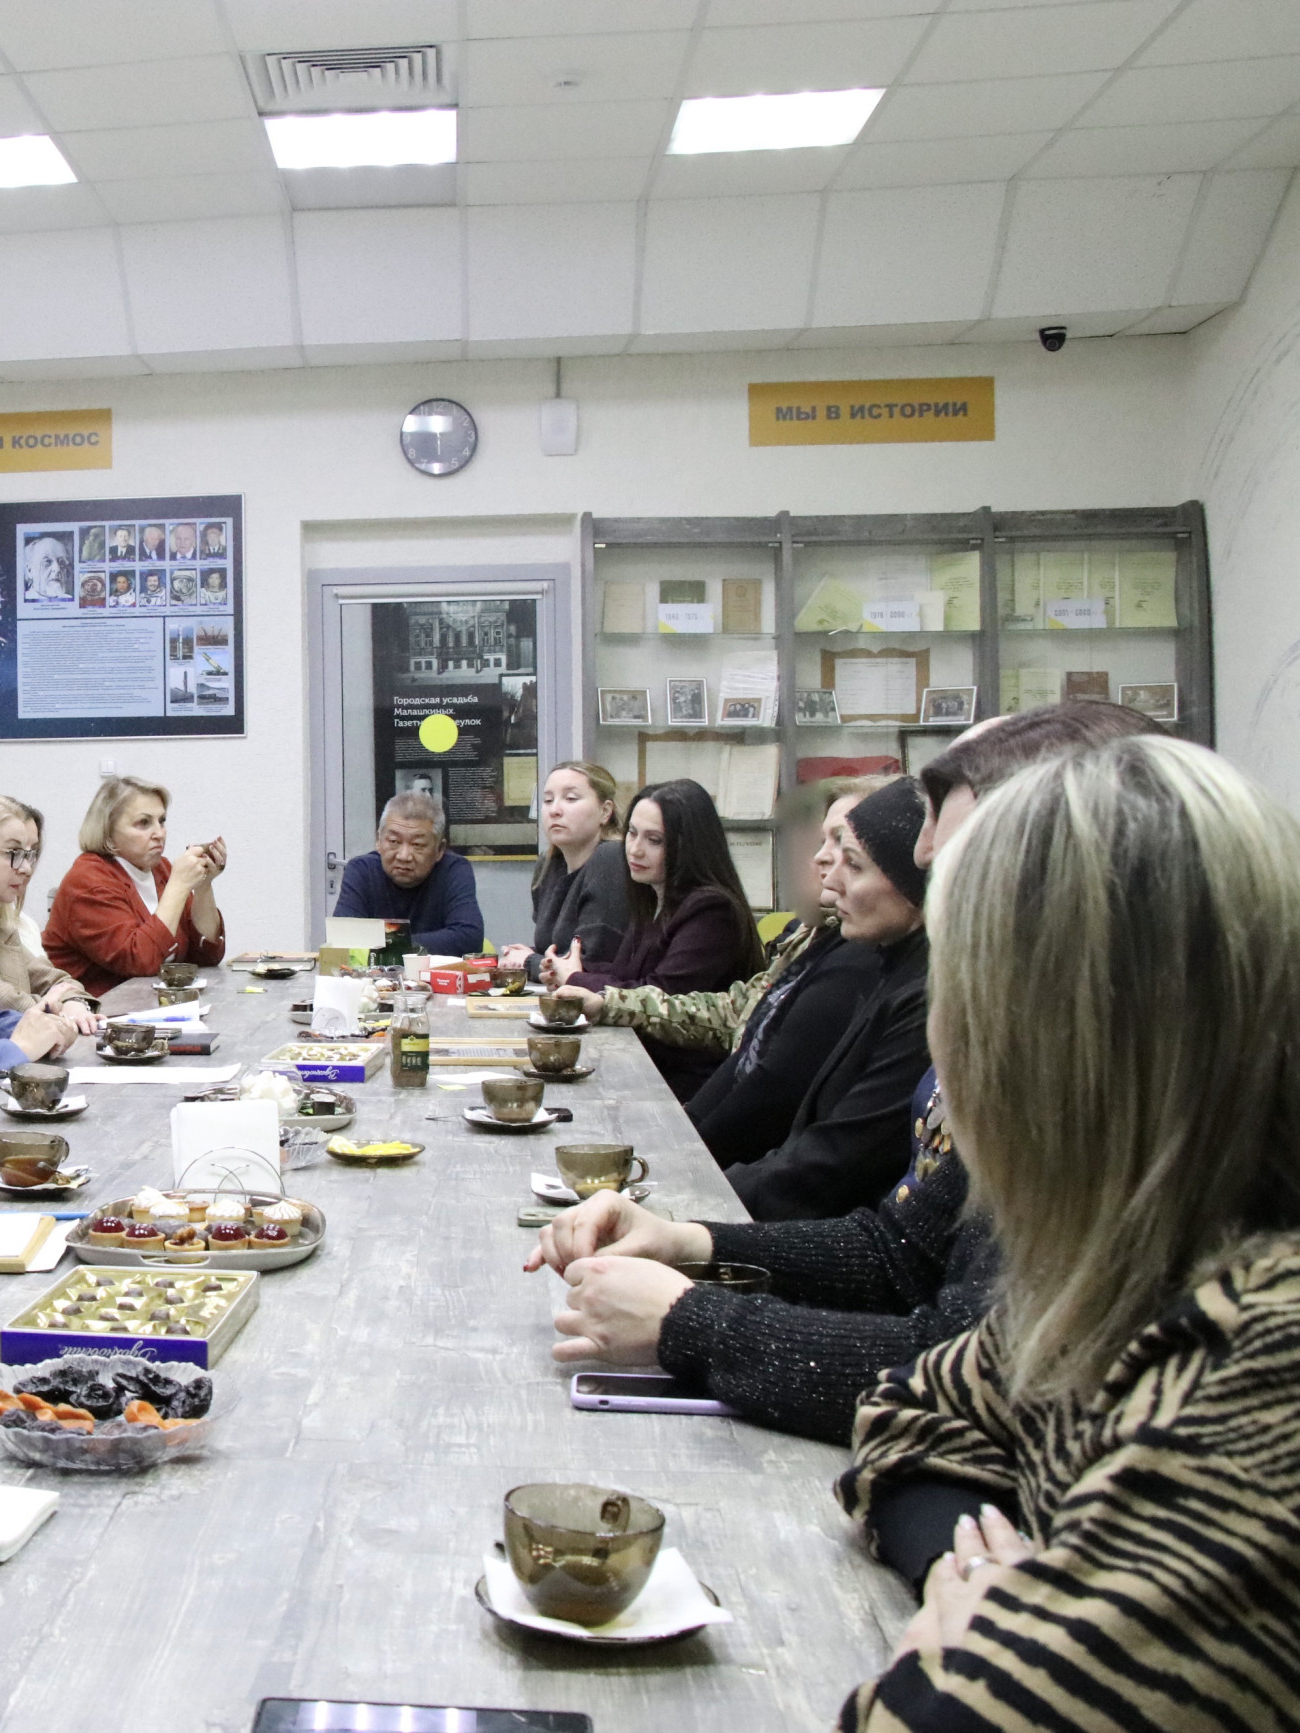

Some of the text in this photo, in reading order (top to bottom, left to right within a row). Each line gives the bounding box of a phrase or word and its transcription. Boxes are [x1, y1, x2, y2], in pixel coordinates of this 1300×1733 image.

[775, 401, 968, 421] МЫ В ИСТОРИИ
[463, 416, 470, 426] 2
[12, 431, 99, 449] КОСМОС
[468, 431, 475, 441] 3
[409, 448, 416, 458] 8
[463, 447, 469, 456] 4
[452, 458, 458, 468] 5
[394, 695, 479, 705] Городская усадьба
[394, 719, 422, 727] Газетн
